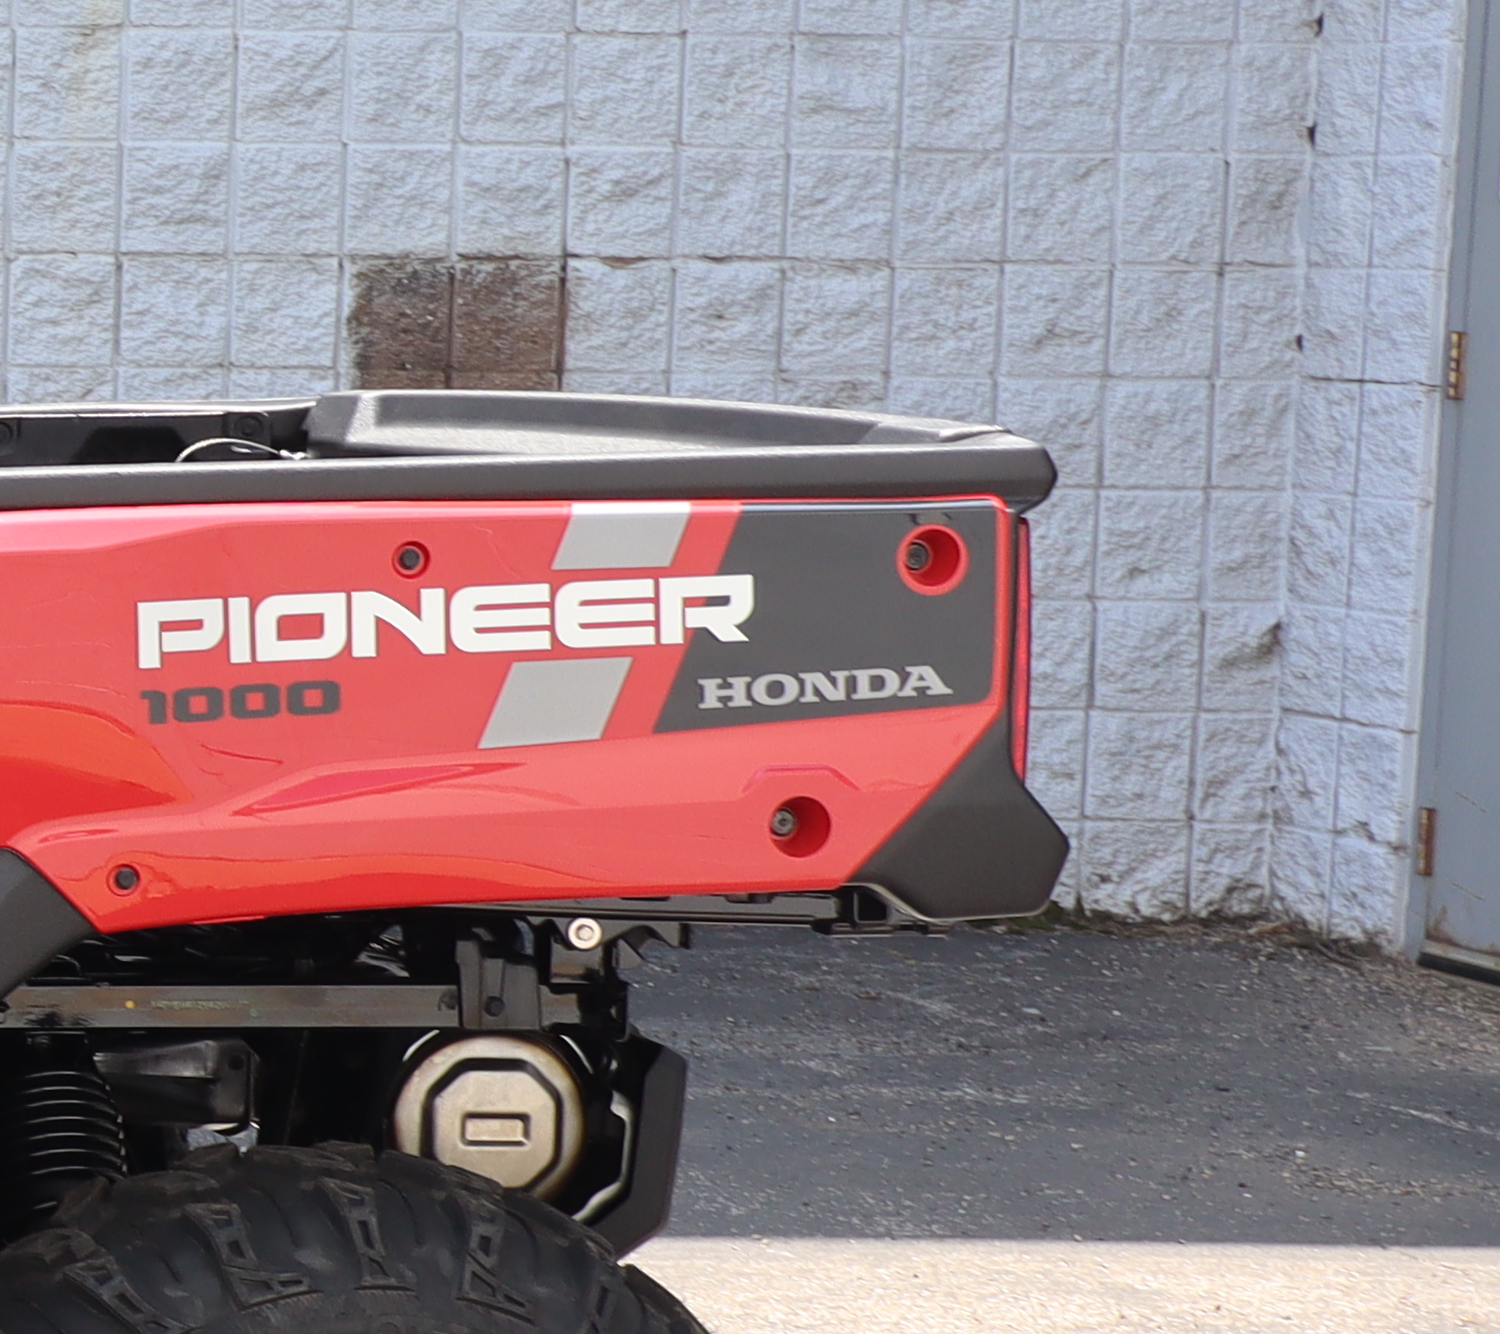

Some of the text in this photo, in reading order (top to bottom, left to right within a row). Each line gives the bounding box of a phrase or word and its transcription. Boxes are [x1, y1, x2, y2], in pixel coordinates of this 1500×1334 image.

[136, 574, 755, 669] PIONEER
[138, 679, 342, 725] 1000
[697, 665, 953, 710] HONDA
